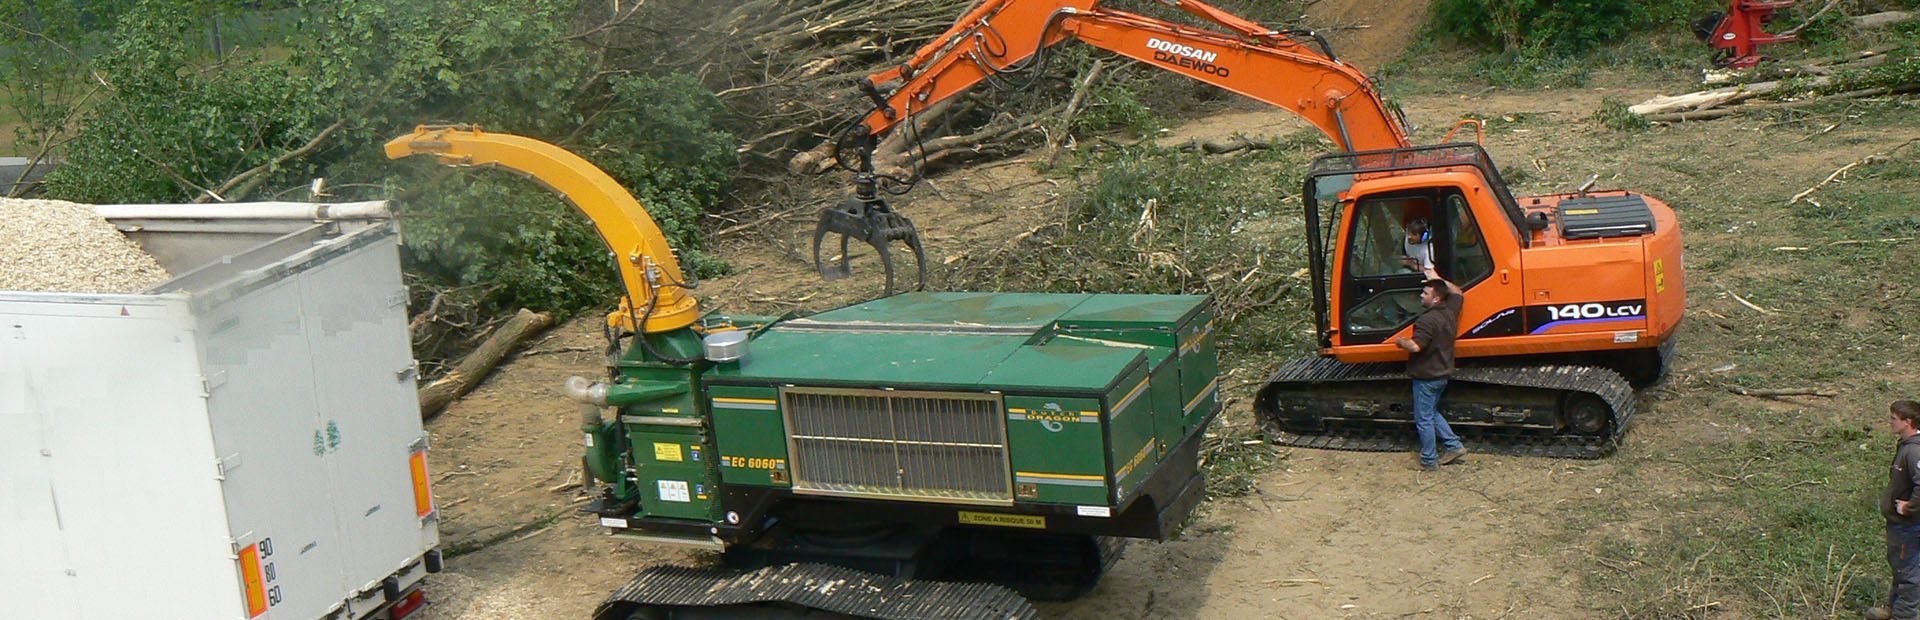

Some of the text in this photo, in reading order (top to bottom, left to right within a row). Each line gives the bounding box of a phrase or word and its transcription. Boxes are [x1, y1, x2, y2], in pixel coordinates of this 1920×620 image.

[1146, 38, 1217, 63] DOOSAN
[1153, 51, 1230, 78] DAEWOO
[1027, 414, 1081, 422] DRAGON
[731, 456, 776, 469] EC 6060
[259, 537, 273, 559] 90
[268, 585, 282, 607] 60
